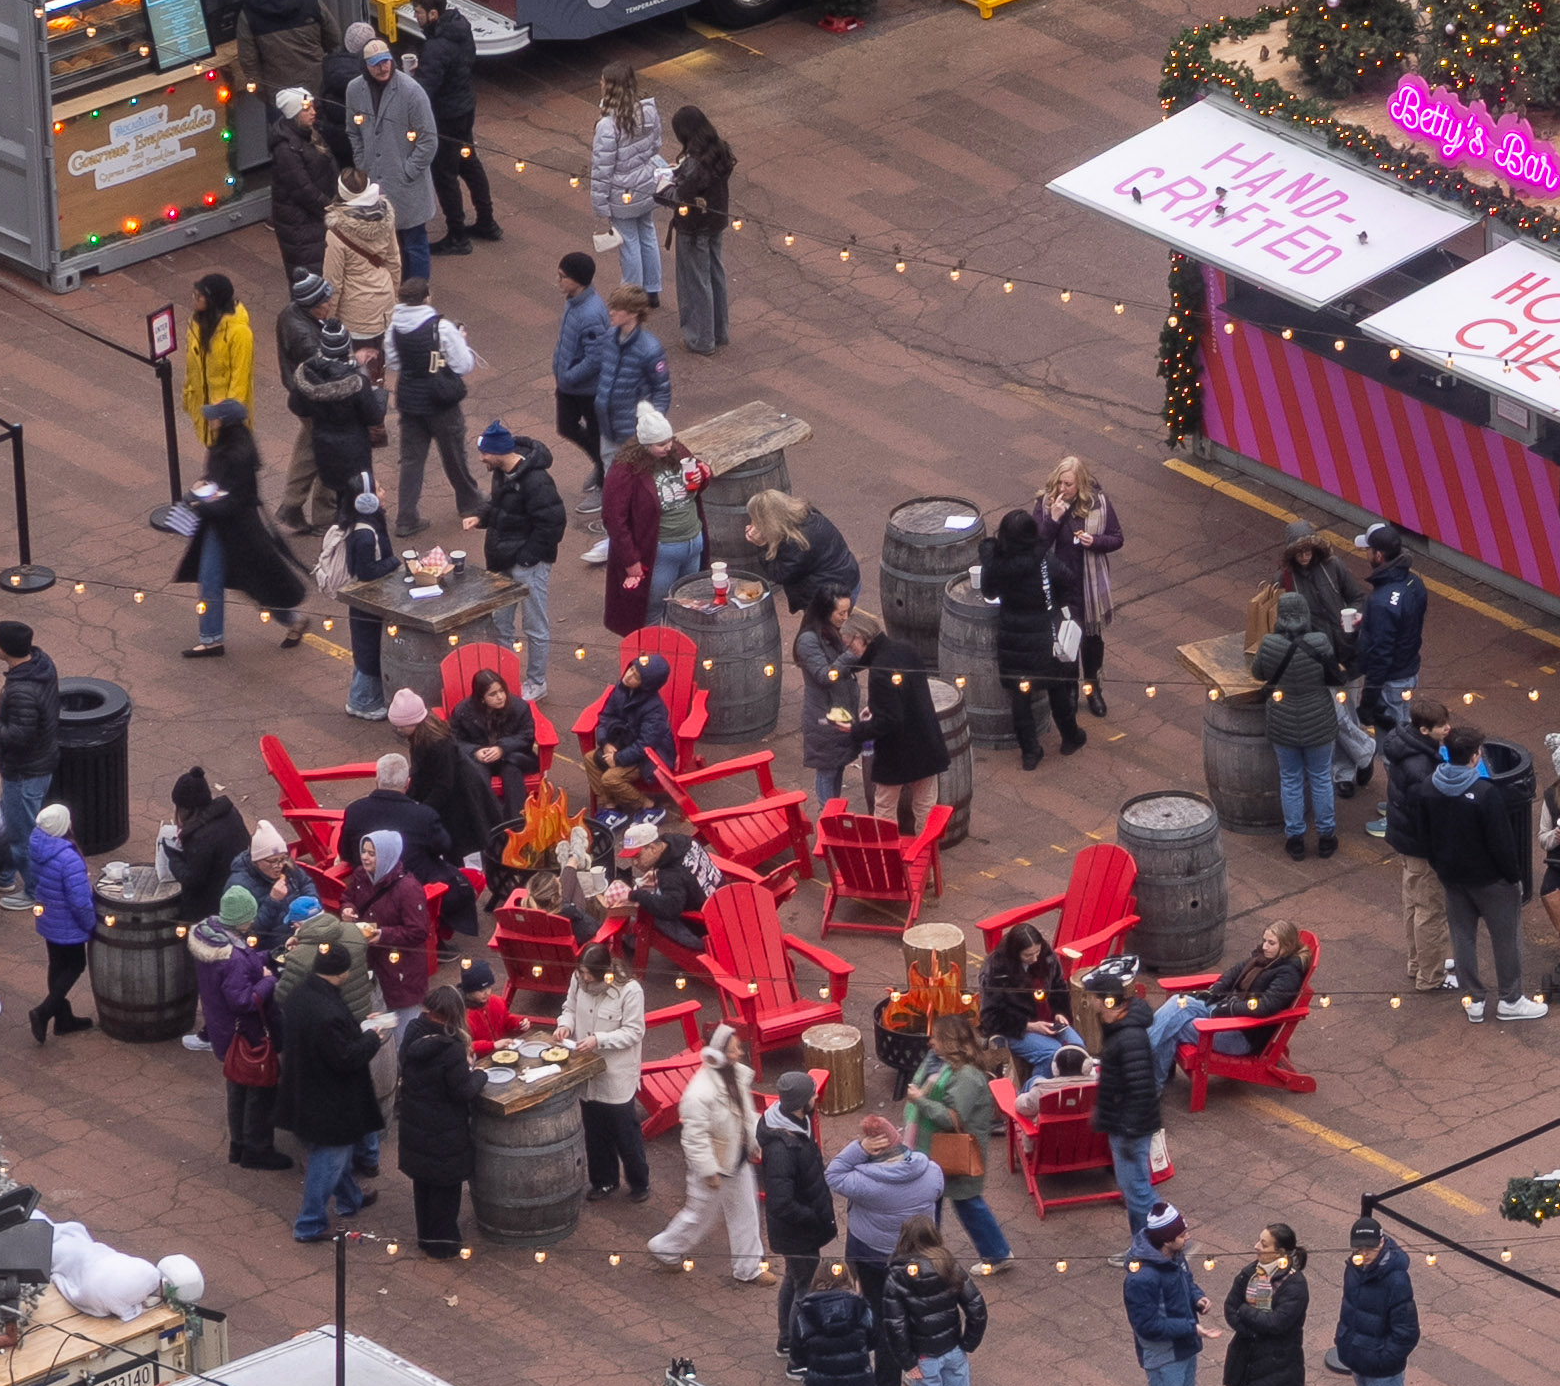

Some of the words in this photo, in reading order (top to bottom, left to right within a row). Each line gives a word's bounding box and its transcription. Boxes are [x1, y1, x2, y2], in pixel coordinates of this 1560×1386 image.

[1388, 81, 1486, 162] Betty's
[1111, 165, 1344, 277] CRAFTED
[1199, 142, 1359, 225] HAND-
